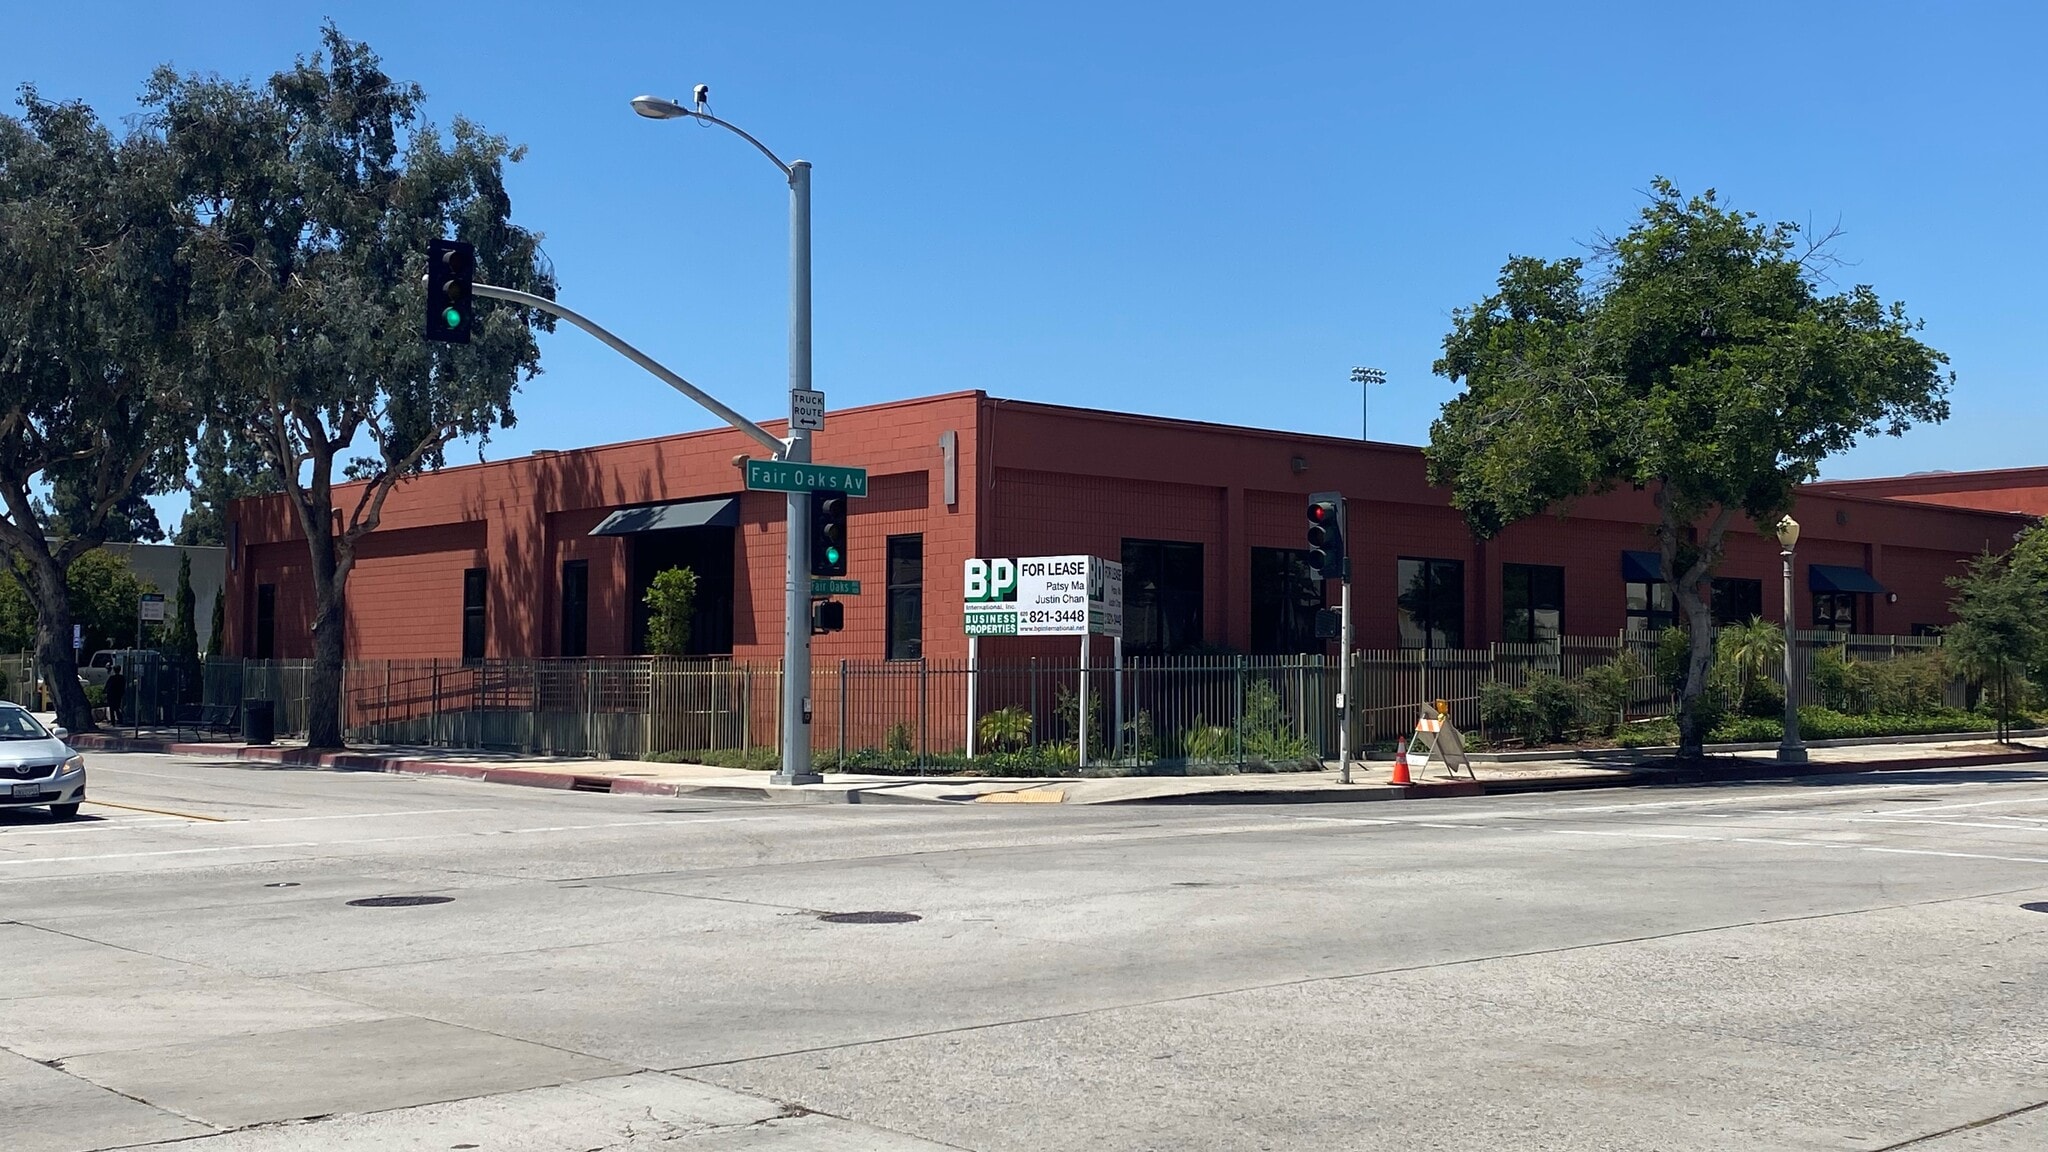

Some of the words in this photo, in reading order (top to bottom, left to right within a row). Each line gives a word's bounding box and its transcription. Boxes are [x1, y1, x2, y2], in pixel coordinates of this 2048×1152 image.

[794, 395, 823, 405] TRUCK
[794, 407, 823, 417] ROUTE
[752, 467, 786, 484] Fair
[794, 470, 837, 488] Oaks
[844, 474, 862, 490] Av
[1022, 563, 1045, 577] FOR
[1048, 562, 1085, 576] LEASE
[964, 558, 1017, 600] BP
[1088, 556, 1104, 599] BP
[830, 580, 849, 592] Oaks
[1046, 581, 1069, 592] Patsy
[1071, 580, 1085, 590] Ma
[1035, 595, 1060, 604] Justin
[1062, 594, 1085, 603] Chan
[965, 614, 1016, 624] BUSINESS
[1029, 610, 1085, 623] 821-3448
[965, 624, 1016, 634] PROPERTIES
